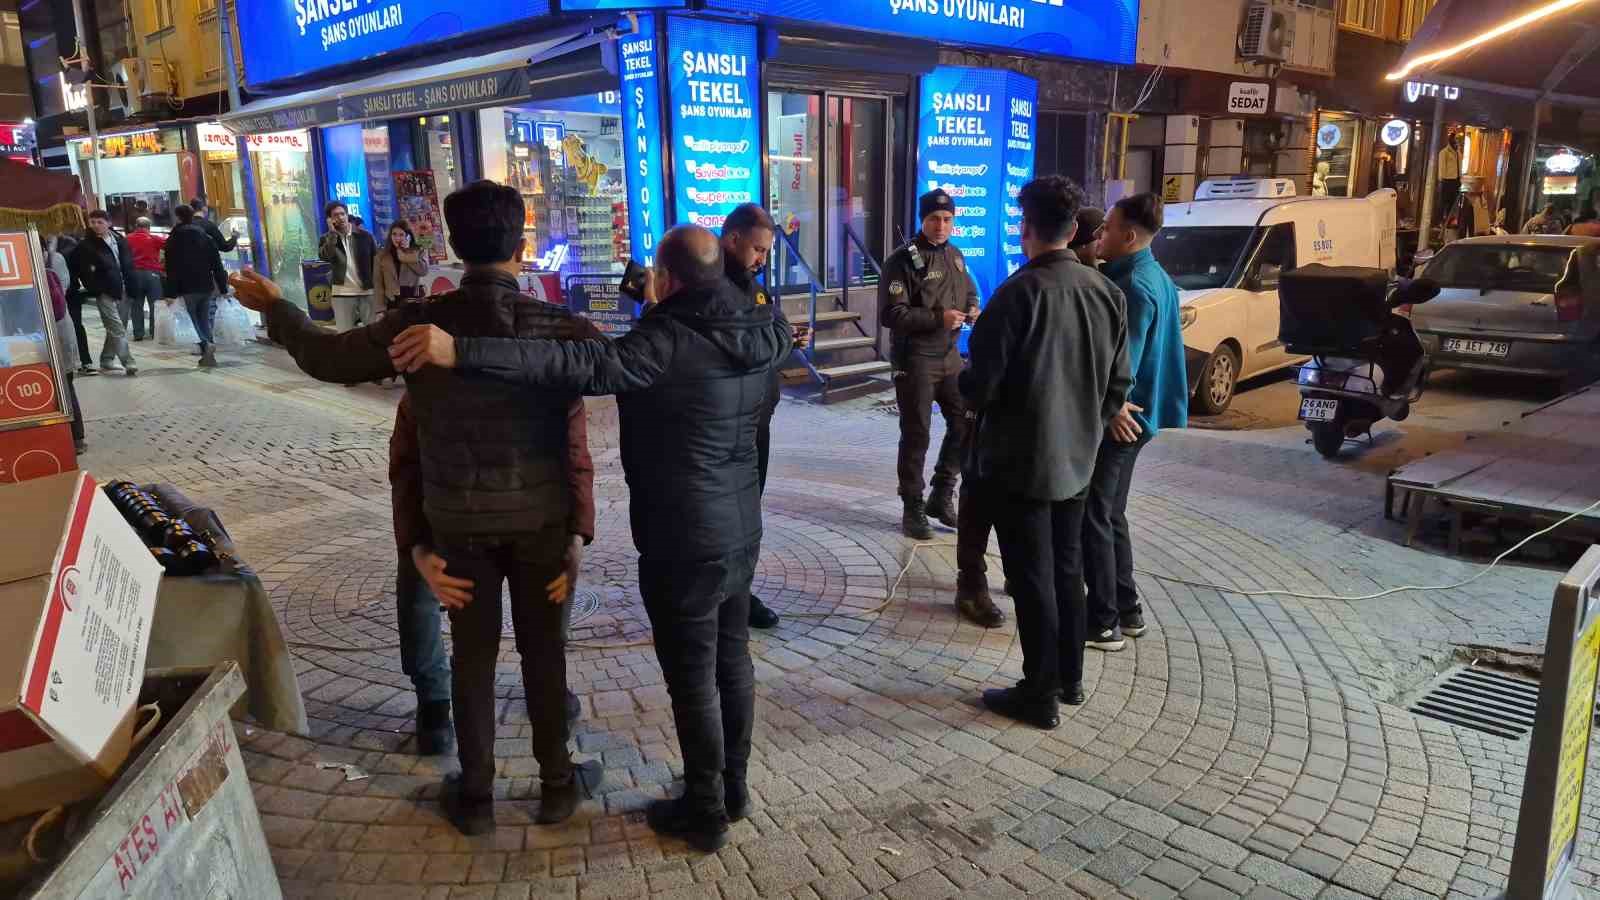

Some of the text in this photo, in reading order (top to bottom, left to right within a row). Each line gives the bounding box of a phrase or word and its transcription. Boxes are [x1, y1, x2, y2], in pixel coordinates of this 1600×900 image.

[943, 0, 1025, 29] OYUNLARI
[321, 4, 403, 51] ŞANS OYUNLARI
[622, 40, 653, 58] ŞANSLI
[625, 56, 652, 70] TEKEL
[683, 50, 747, 77] ŞANSLI
[392, 91, 418, 109] TEKEL
[424, 86, 447, 108] ŞANS
[450, 77, 497, 101] OYUNLARI
[688, 80, 744, 104] TEKEL
[681, 104, 752, 119] ŞANS OYUNLARI
[933, 92, 991, 114] ŞANSLI
[1011, 97, 1032, 118] ŞANSLI
[1231, 97, 1265, 109] SEDAT
[936, 116, 986, 135] TEKEL
[1011, 120, 1030, 139] TEKEL
[928, 136, 992, 147] ŞANS OYUNLARI
[336, 182, 360, 200] ŞANSLI
[1488, 342, 1507, 353] 749
[16, 382, 42, 397] 100
